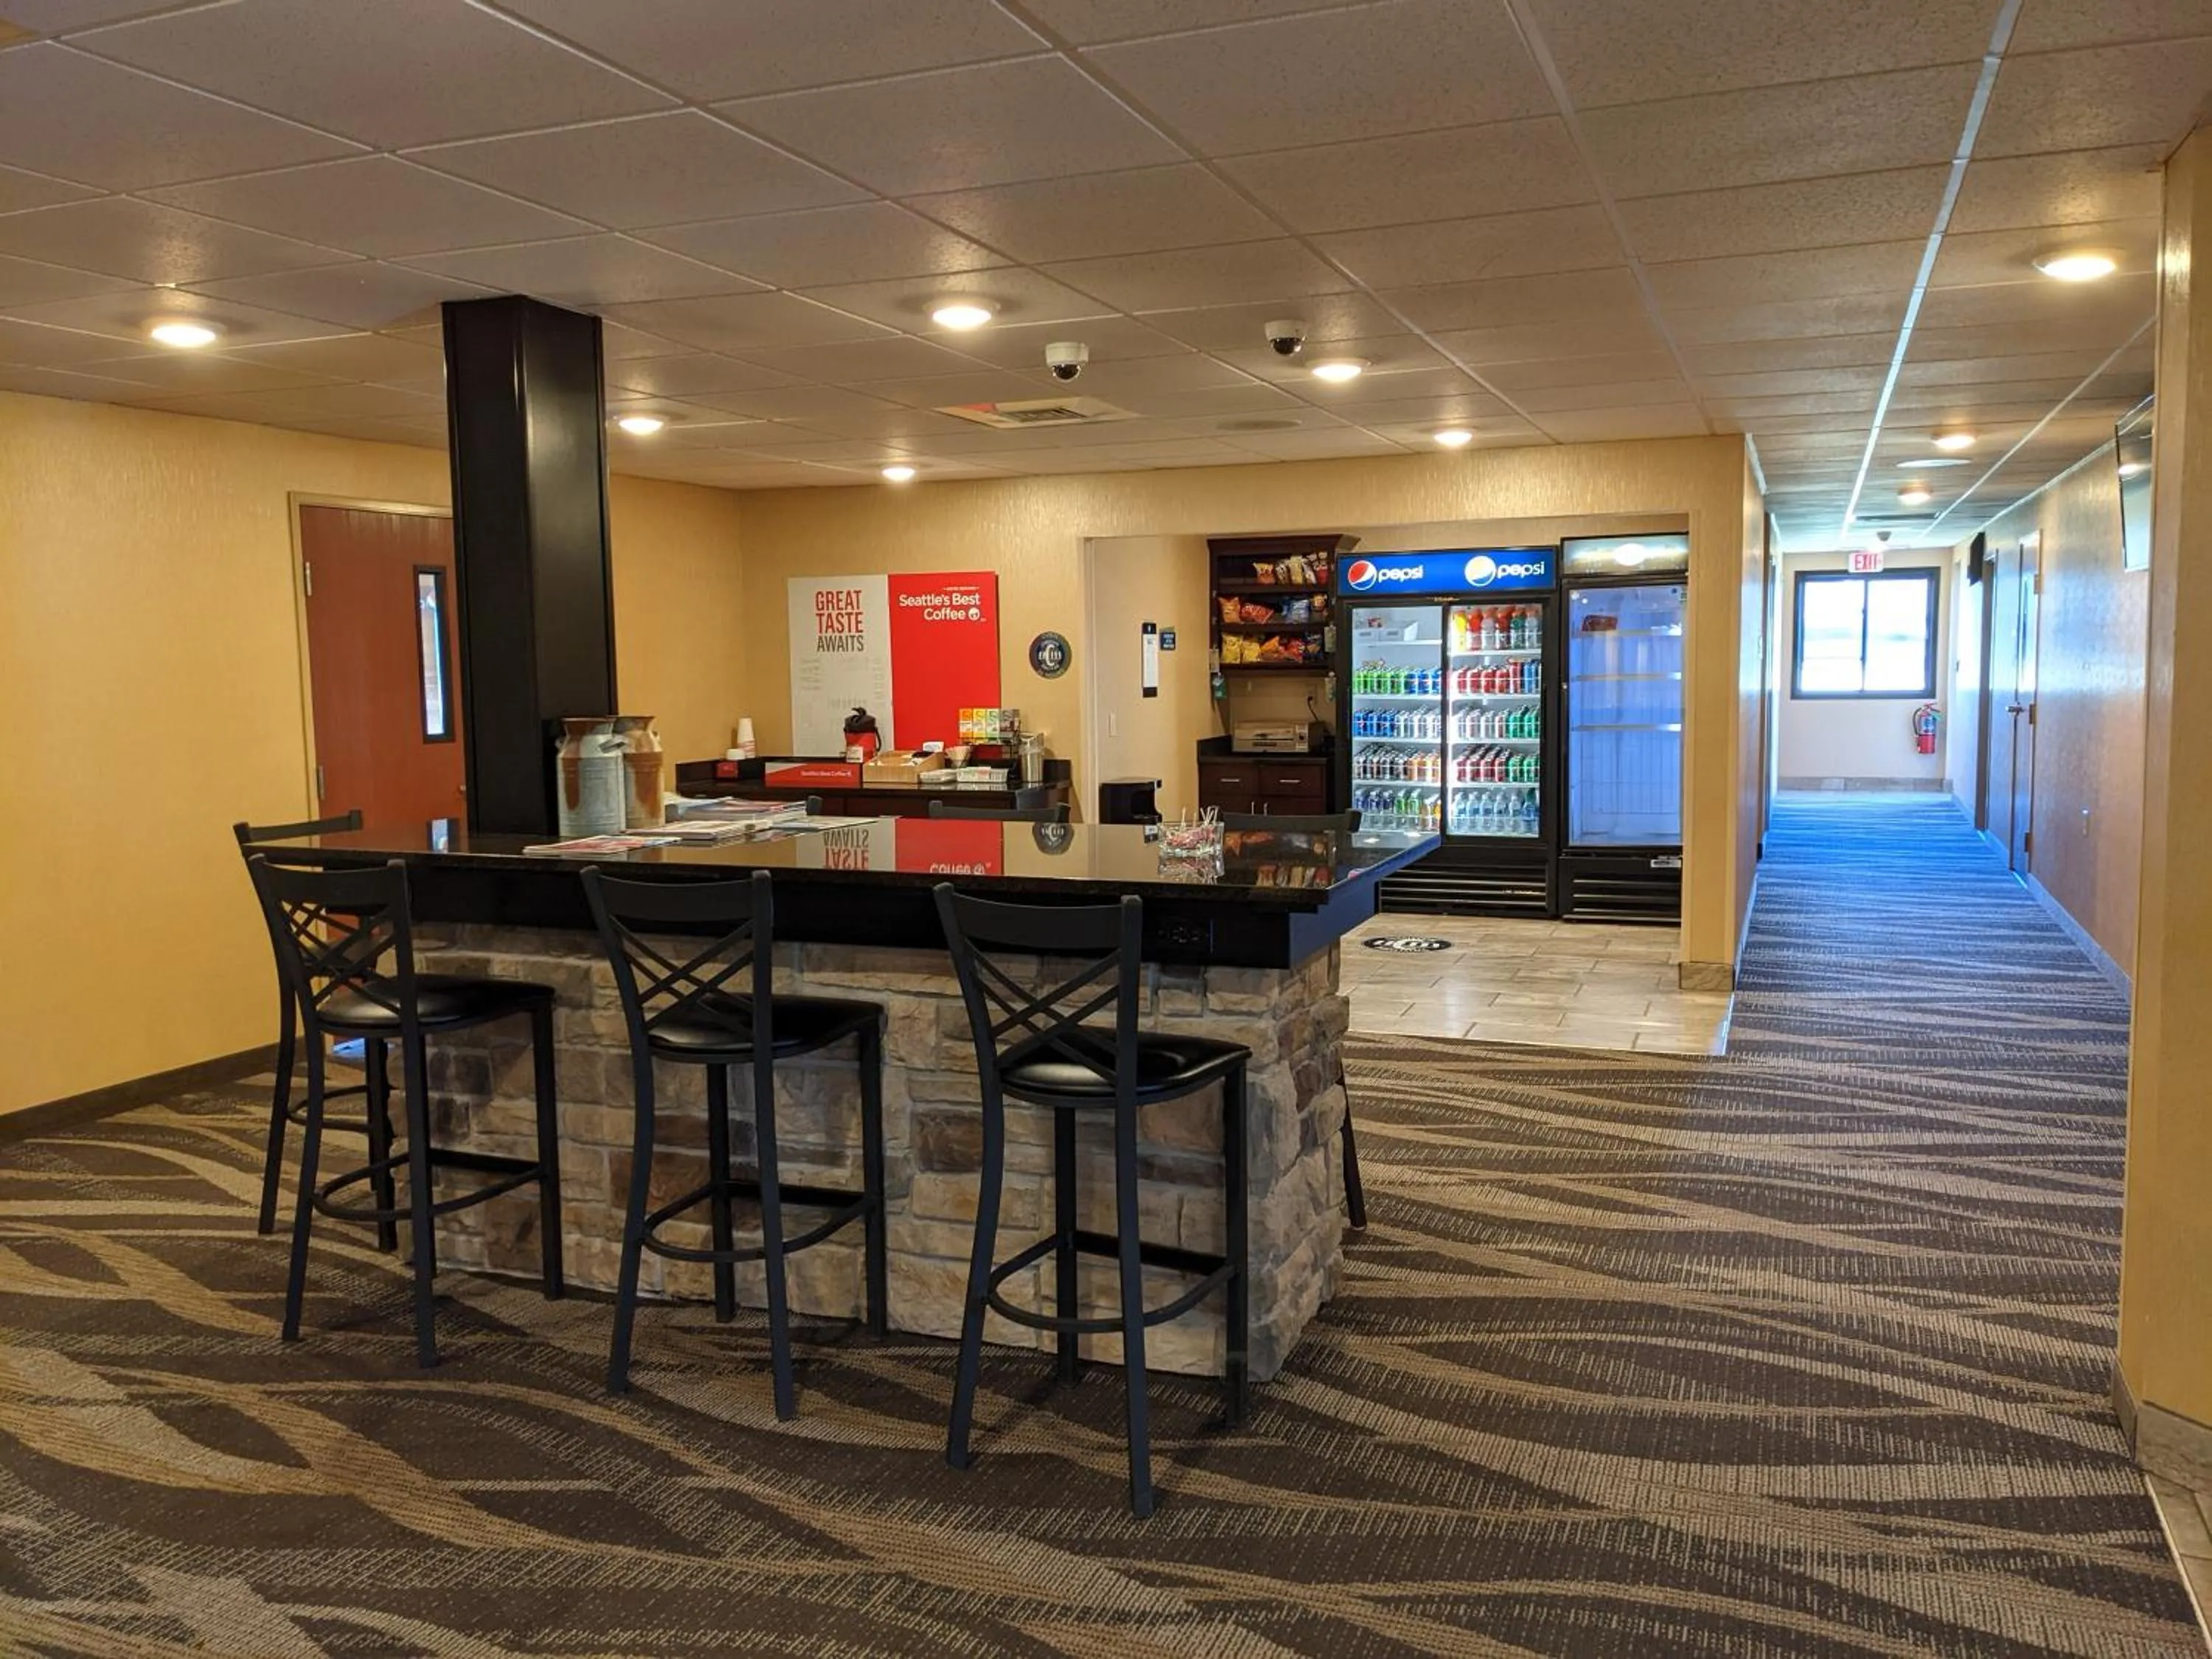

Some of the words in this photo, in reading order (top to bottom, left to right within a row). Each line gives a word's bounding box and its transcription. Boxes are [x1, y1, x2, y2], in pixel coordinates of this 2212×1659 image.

[1498, 561, 1545, 579] pepsi
[1854, 554, 1878, 571] EXIT
[1378, 565, 1424, 583] pepsi
[815, 590, 862, 611] GREAT
[899, 594, 950, 606] Seattle's
[952, 593, 981, 605] Best
[815, 612, 863, 633] TASTE
[924, 608, 966, 620] Coffee
[816, 635, 864, 653] AWAITS
